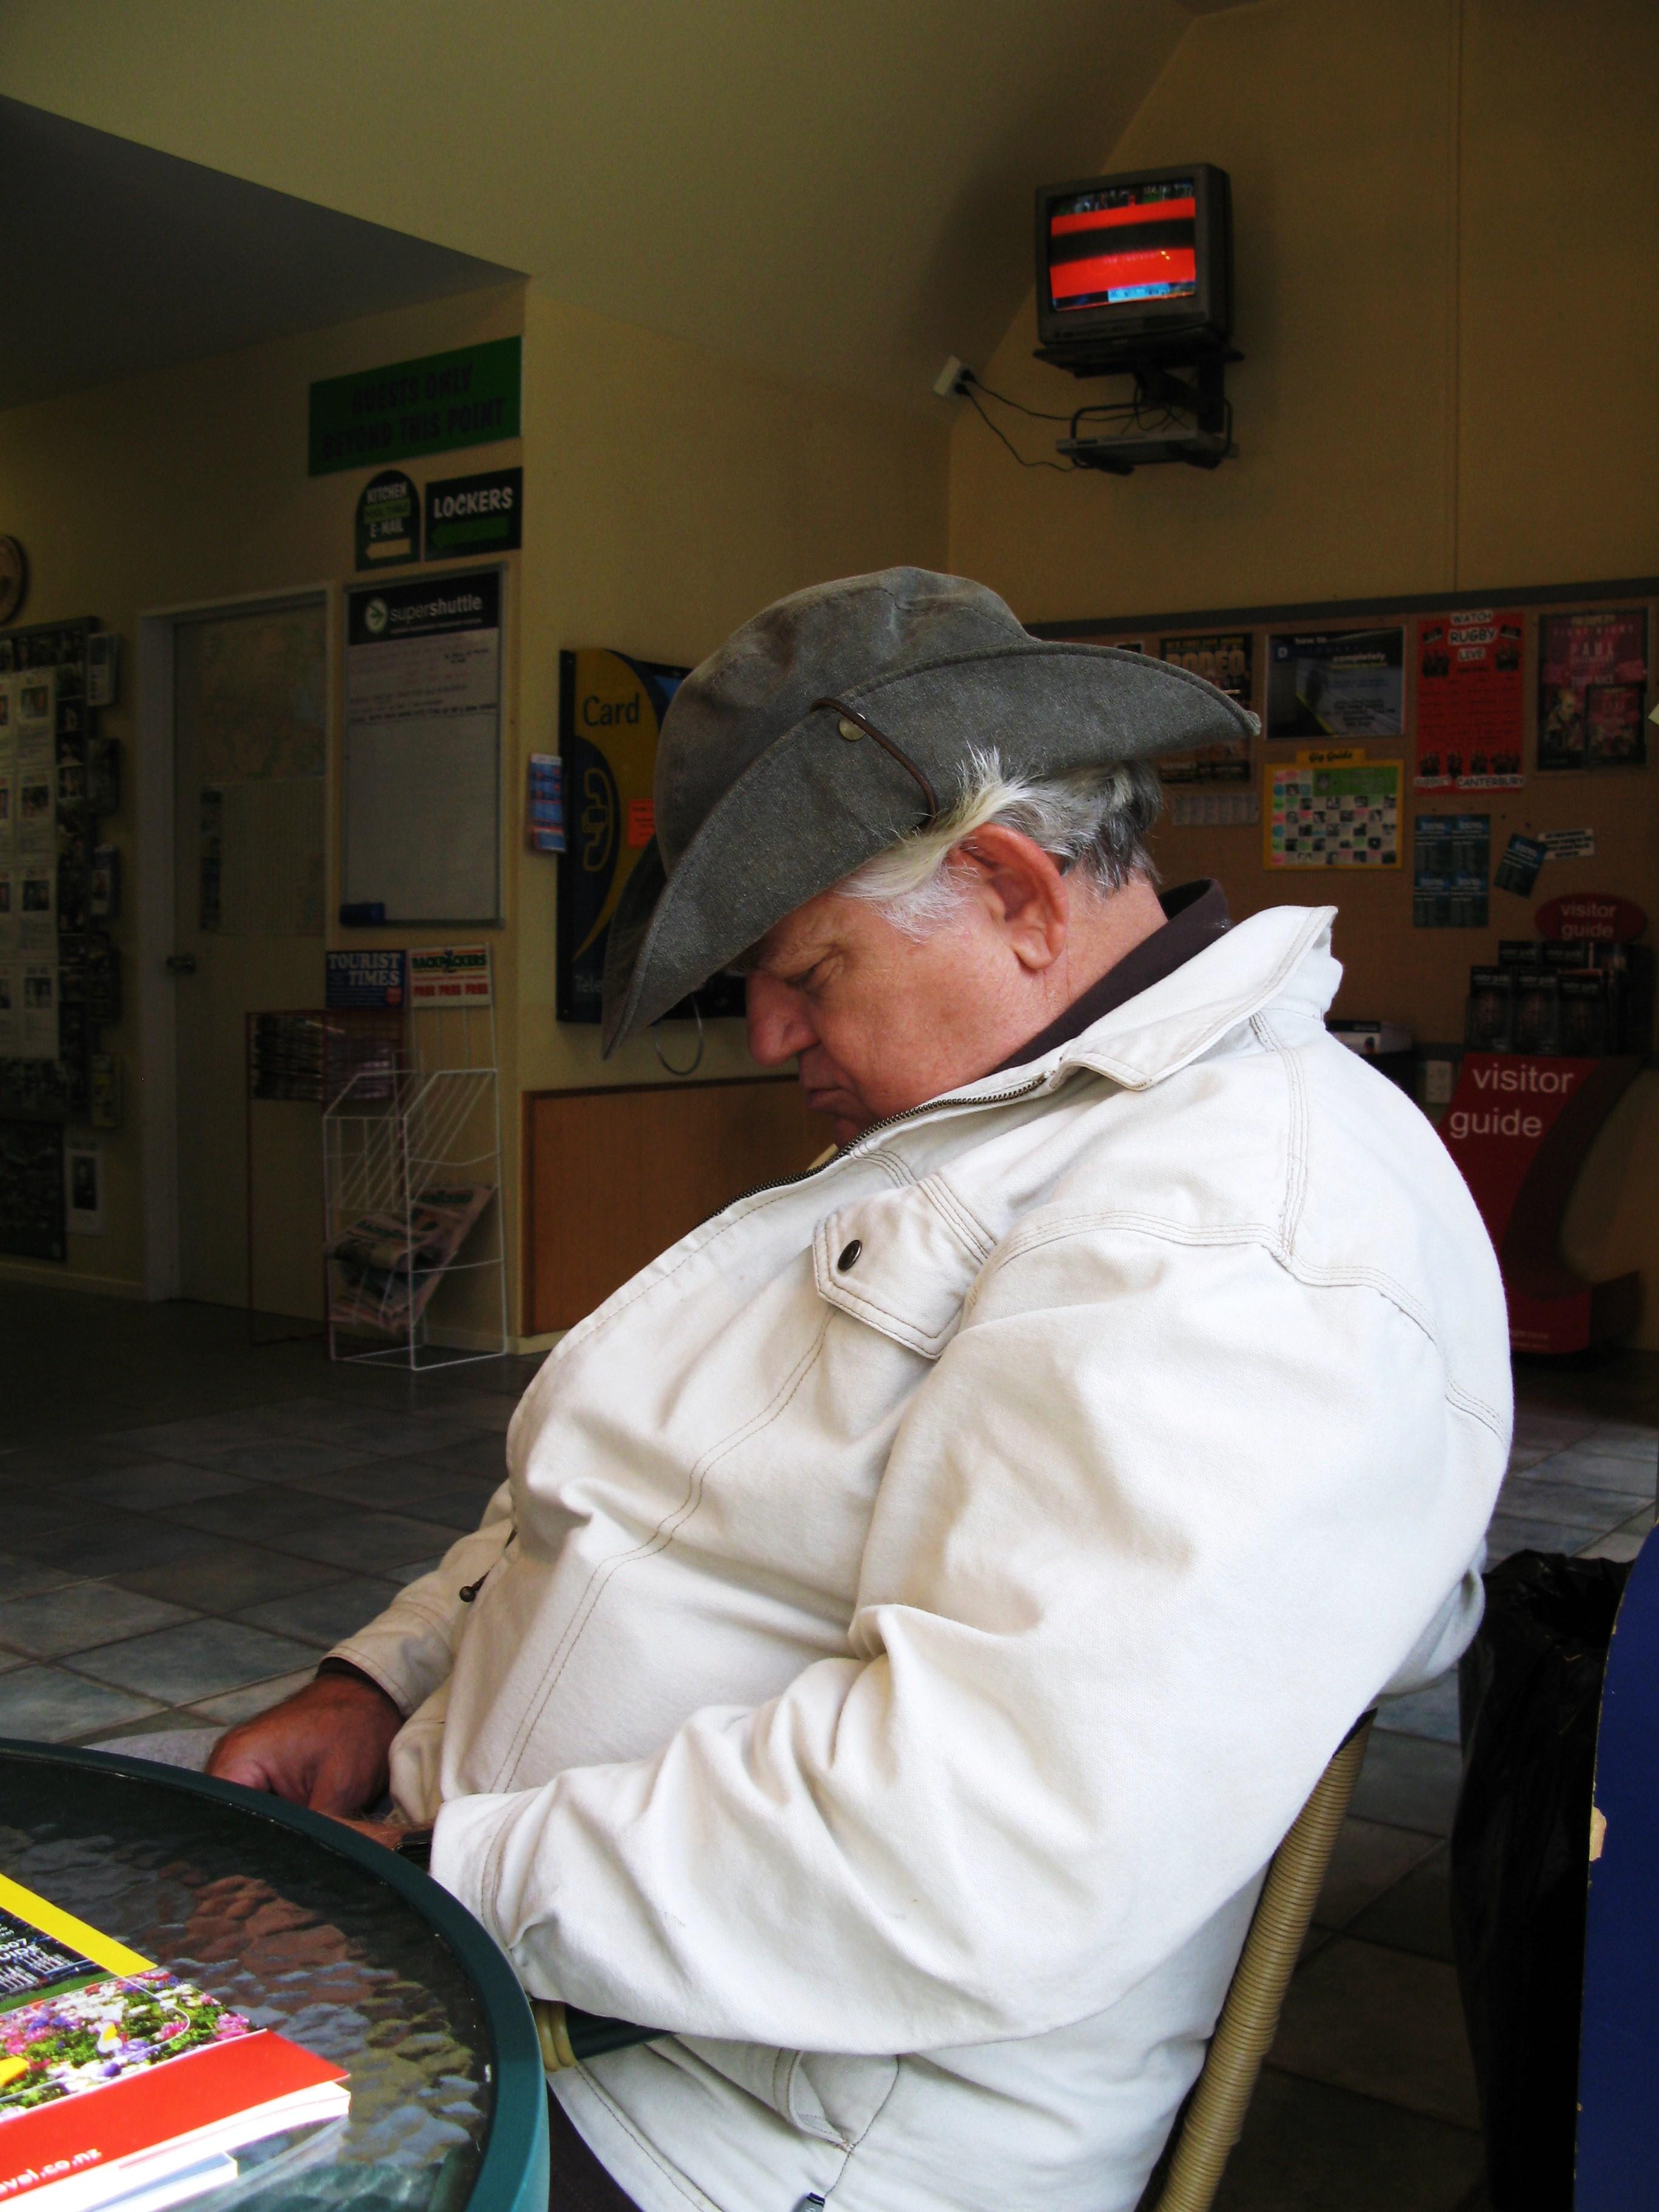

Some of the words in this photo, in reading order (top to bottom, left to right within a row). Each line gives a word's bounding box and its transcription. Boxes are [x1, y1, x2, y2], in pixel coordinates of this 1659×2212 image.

[426, 361, 473, 401] ONLY
[321, 422, 392, 461] BEYOND
[398, 412, 440, 445] THIS
[447, 396, 504, 435] POINT
[433, 486, 514, 520] LOCKERS
[389, 592, 483, 625] supershuttle
[1453, 612, 1492, 623] WATCH
[1450, 628, 1496, 643] RUGBY
[1459, 648, 1484, 660] LIVE
[581, 692, 641, 727] Card
[1326, 750, 1353, 762] Guide
[1455, 776, 1524, 787] CANTERBURY
[1560, 902, 1617, 918] visitor
[1561, 922, 1615, 940] guide
[327, 952, 401, 970] TOURIST
[347, 970, 401, 987] TIMES
[1472, 1062, 1575, 1094] visitor
[1449, 1106, 1544, 1140] guide
